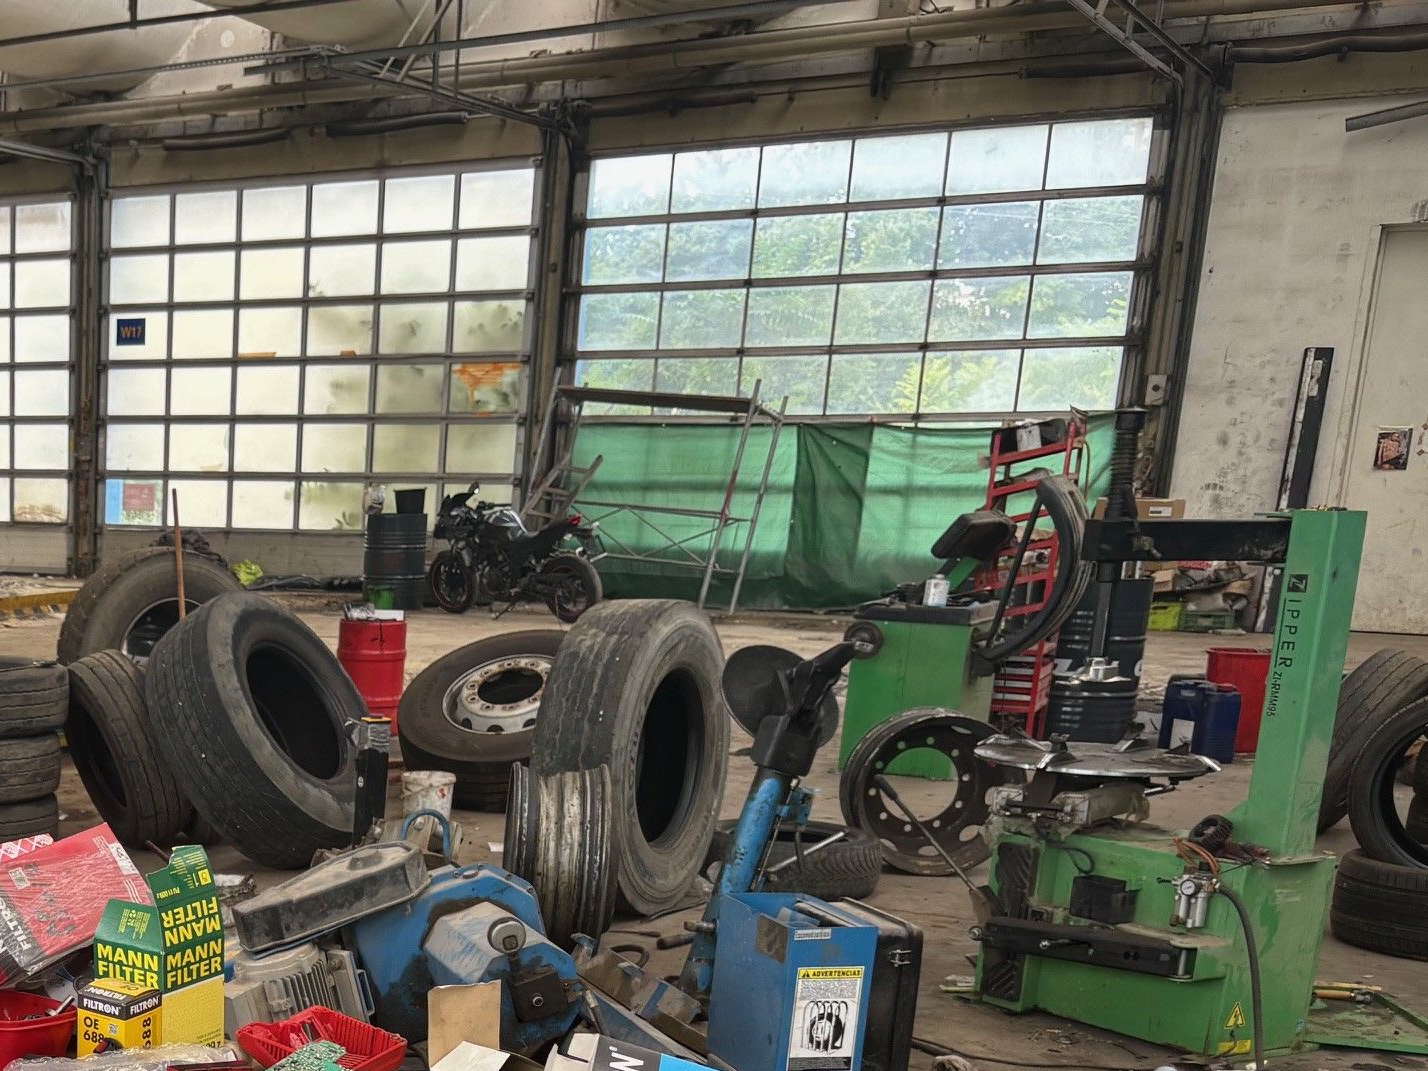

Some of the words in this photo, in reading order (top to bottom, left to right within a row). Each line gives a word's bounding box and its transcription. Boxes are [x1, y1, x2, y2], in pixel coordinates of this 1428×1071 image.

[162, 896, 219, 928] FILTER
[164, 914, 222, 947] MANN
[97, 943, 159, 972] MANN
[166, 938, 222, 971] MANN
[98, 960, 159, 989] FILTER
[166, 956, 222, 989] FILTER
[811, 969, 861, 977] ADVERTENCIAS
[83, 998, 119, 1016] FILTRON
[130, 995, 159, 1015] FILTRON
[83, 1016, 99, 1030] OE
